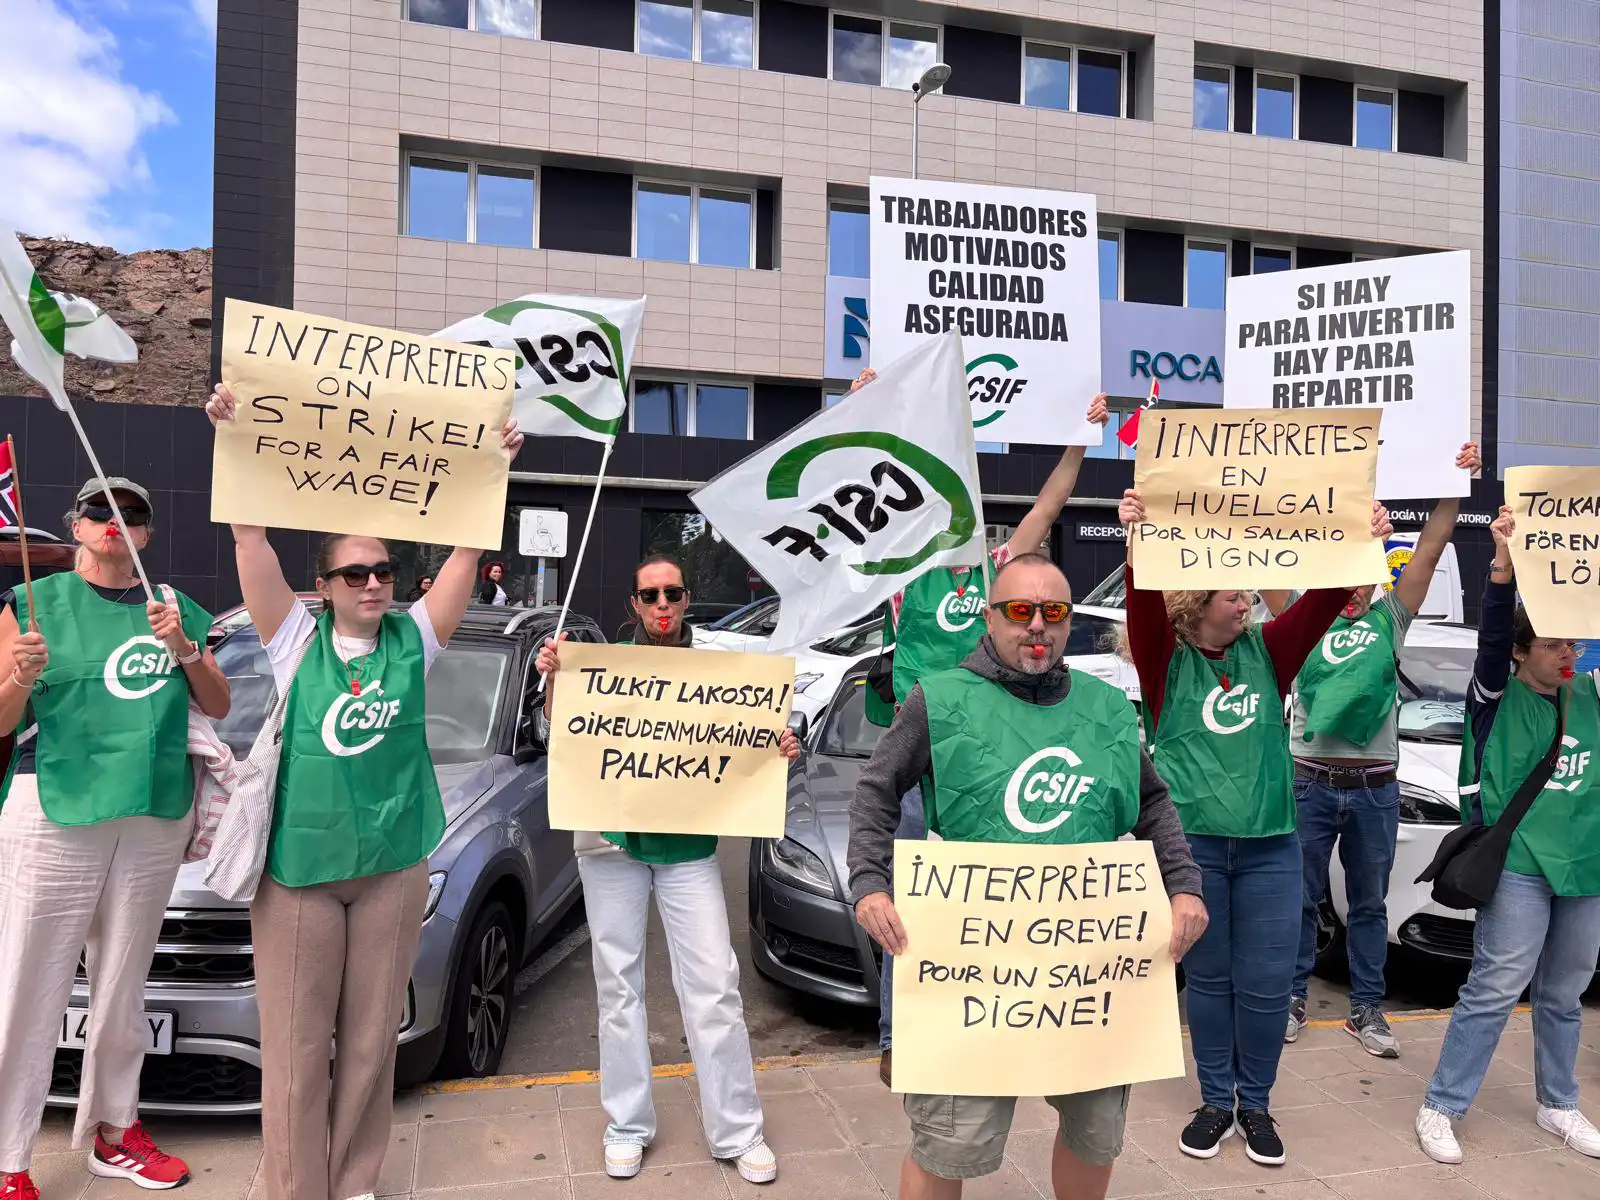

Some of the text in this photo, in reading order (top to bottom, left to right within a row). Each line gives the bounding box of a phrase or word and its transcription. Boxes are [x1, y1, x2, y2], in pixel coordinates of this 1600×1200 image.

[880, 195, 1087, 238] TRABAJADORES
[905, 231, 1066, 271] MOTIVADOS
[928, 269, 1044, 304] CALIDAD
[1297, 275, 1392, 311] SI HAY
[904, 303, 1069, 342] ASEGURADA
[1238, 302, 1456, 349] PARA INVERTIR
[244, 314, 512, 392] INTERPRETERS
[1129, 349, 1224, 384] ROCA
[1273, 339, 1415, 377] HAY PARA
[316, 376, 373, 401] ON
[1272, 373, 1414, 409] REPARTIR
[255, 435, 324, 461] FOR
[338, 444, 362, 464] A
[286, 465, 440, 517] WAGE!
[1221, 466, 1267, 487] EN
[1173, 486, 1335, 518] HUELGA!
[1080, 526, 1128, 538] RECEPCI
[1194, 526, 1232, 541] UN
[1550, 559, 1600, 586] LÖ
[1333, 629, 1380, 649] CSIF
[340, 699, 400, 730] CSIF
[676, 681, 790, 714] LAKOSSA!
[600, 748, 732, 784] PALKKA!
[1553, 750, 1591, 779] SIF
[1023, 771, 1095, 805] CSIF
[960, 910, 1149, 947] EN GREVE!
[918, 959, 985, 984] POUR
[992, 965, 1039, 989] UN
